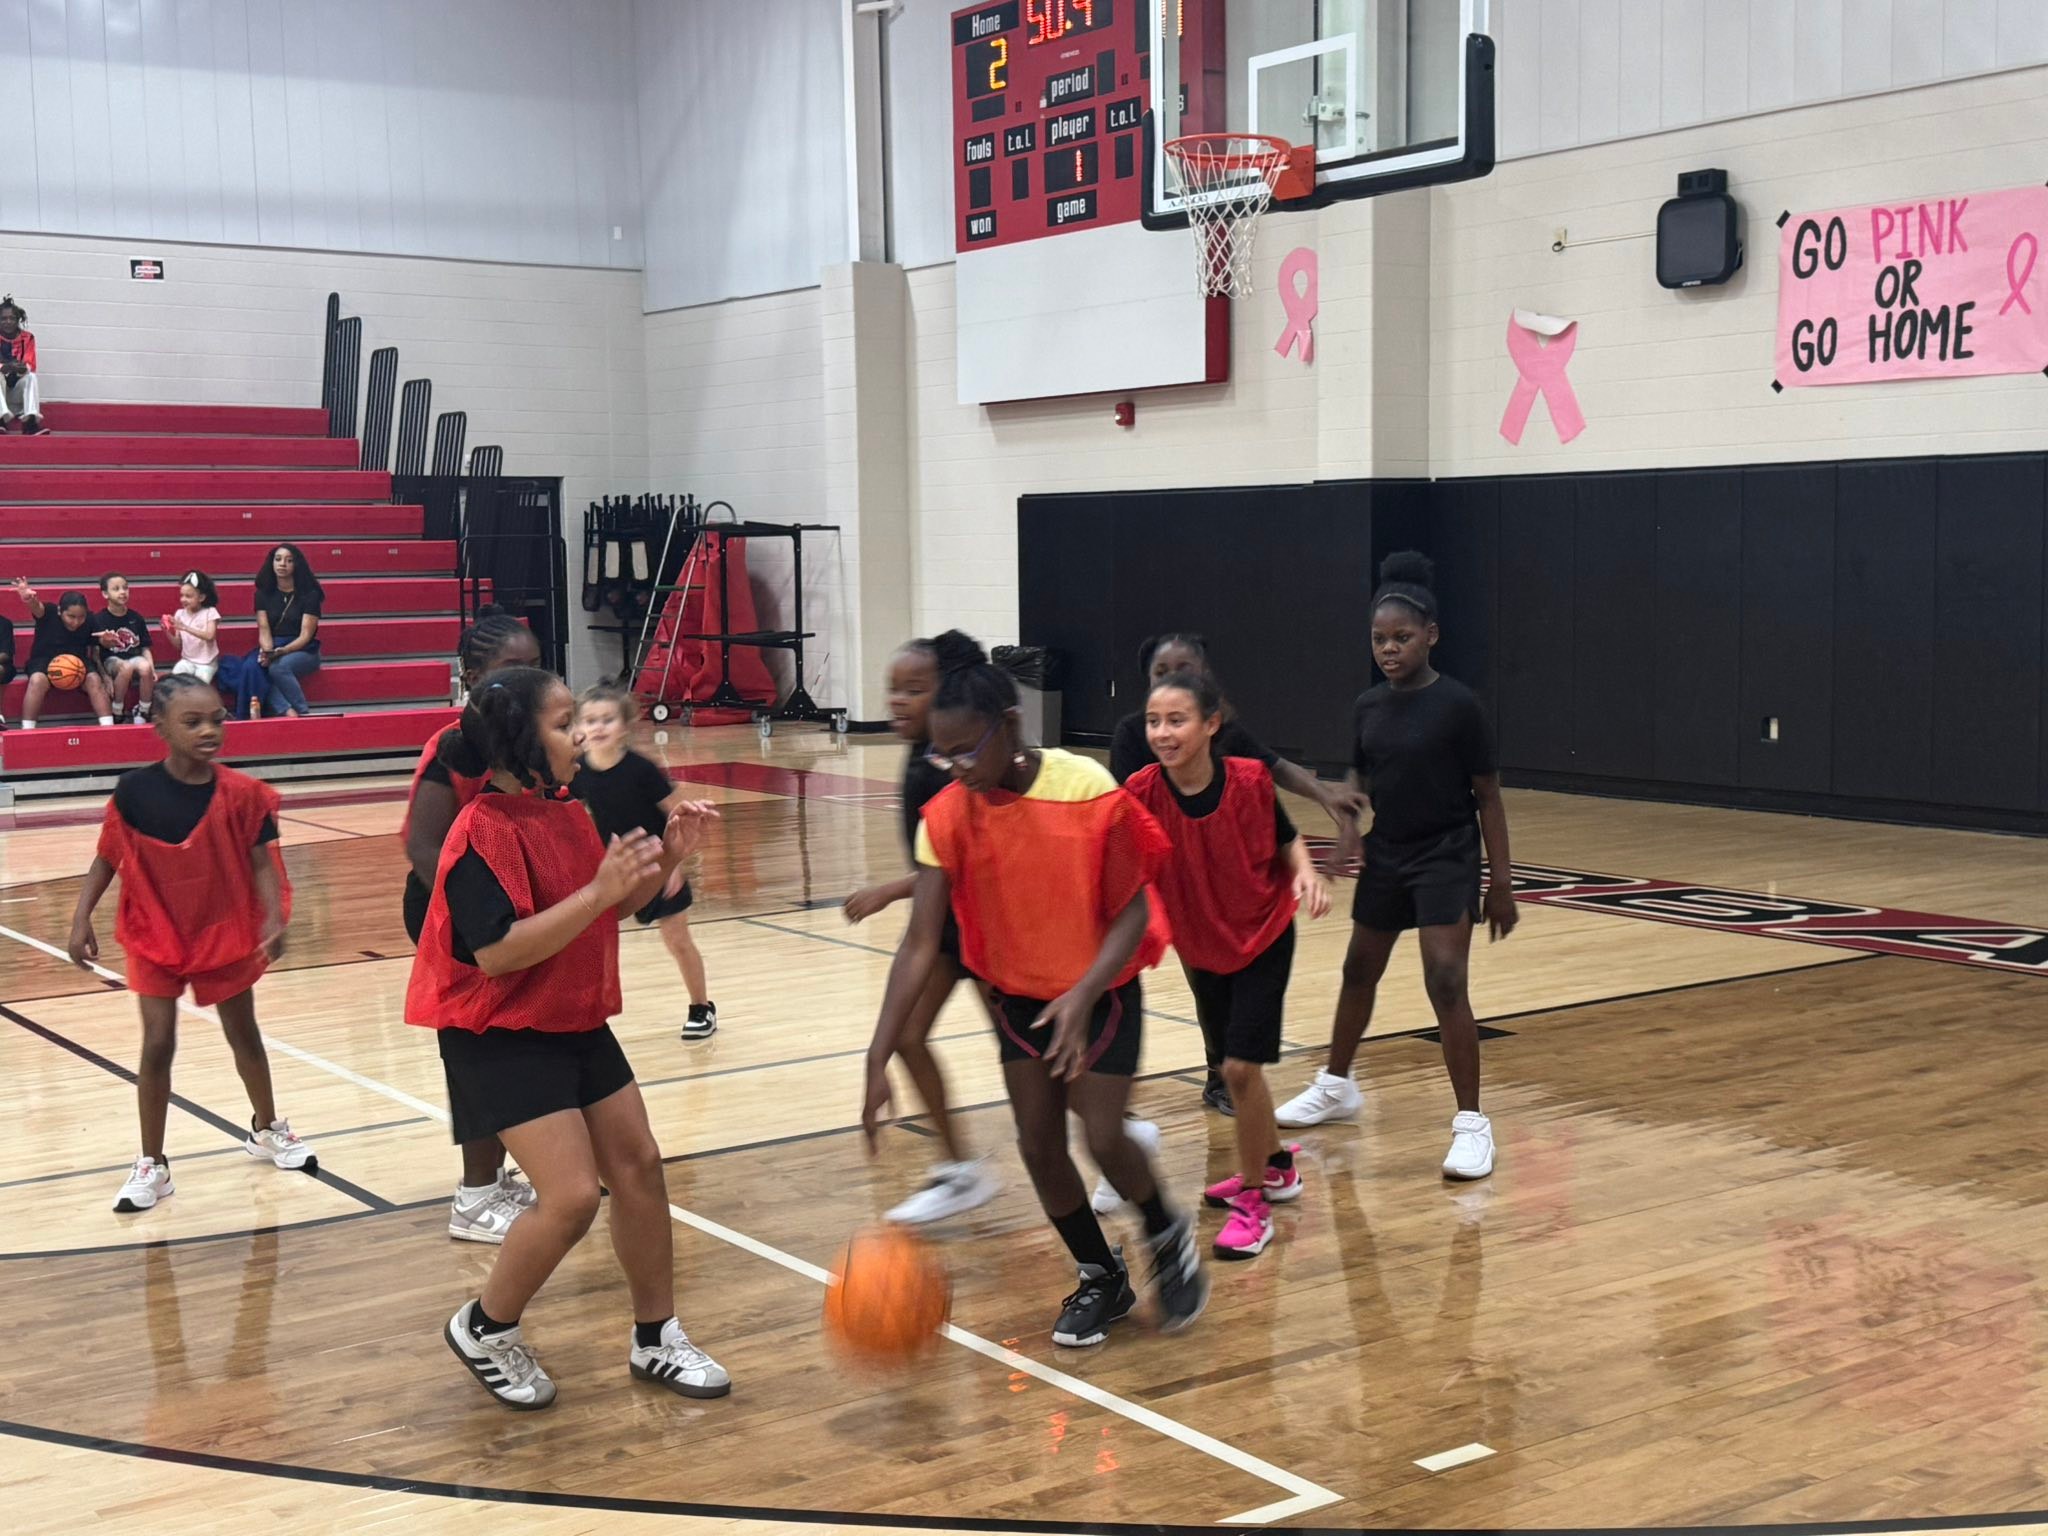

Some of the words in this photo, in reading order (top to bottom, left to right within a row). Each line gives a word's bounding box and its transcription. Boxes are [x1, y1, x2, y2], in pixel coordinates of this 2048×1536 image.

[971, 14, 1001, 38] Home
[989, 38, 1007, 90] 2
[1051, 68, 1089, 99] period
[1051, 114, 1090, 144] player
[966, 138, 992, 162] fouls
[1075, 149, 1083, 182] 1
[970, 216, 992, 236] won
[1056, 198, 1086, 223] game
[1792, 216, 1847, 279] GO
[1871, 198, 1969, 264] PINK
[1875, 259, 1922, 309] OR
[1792, 317, 1838, 372] GO
[1868, 301, 1976, 363] HOME
